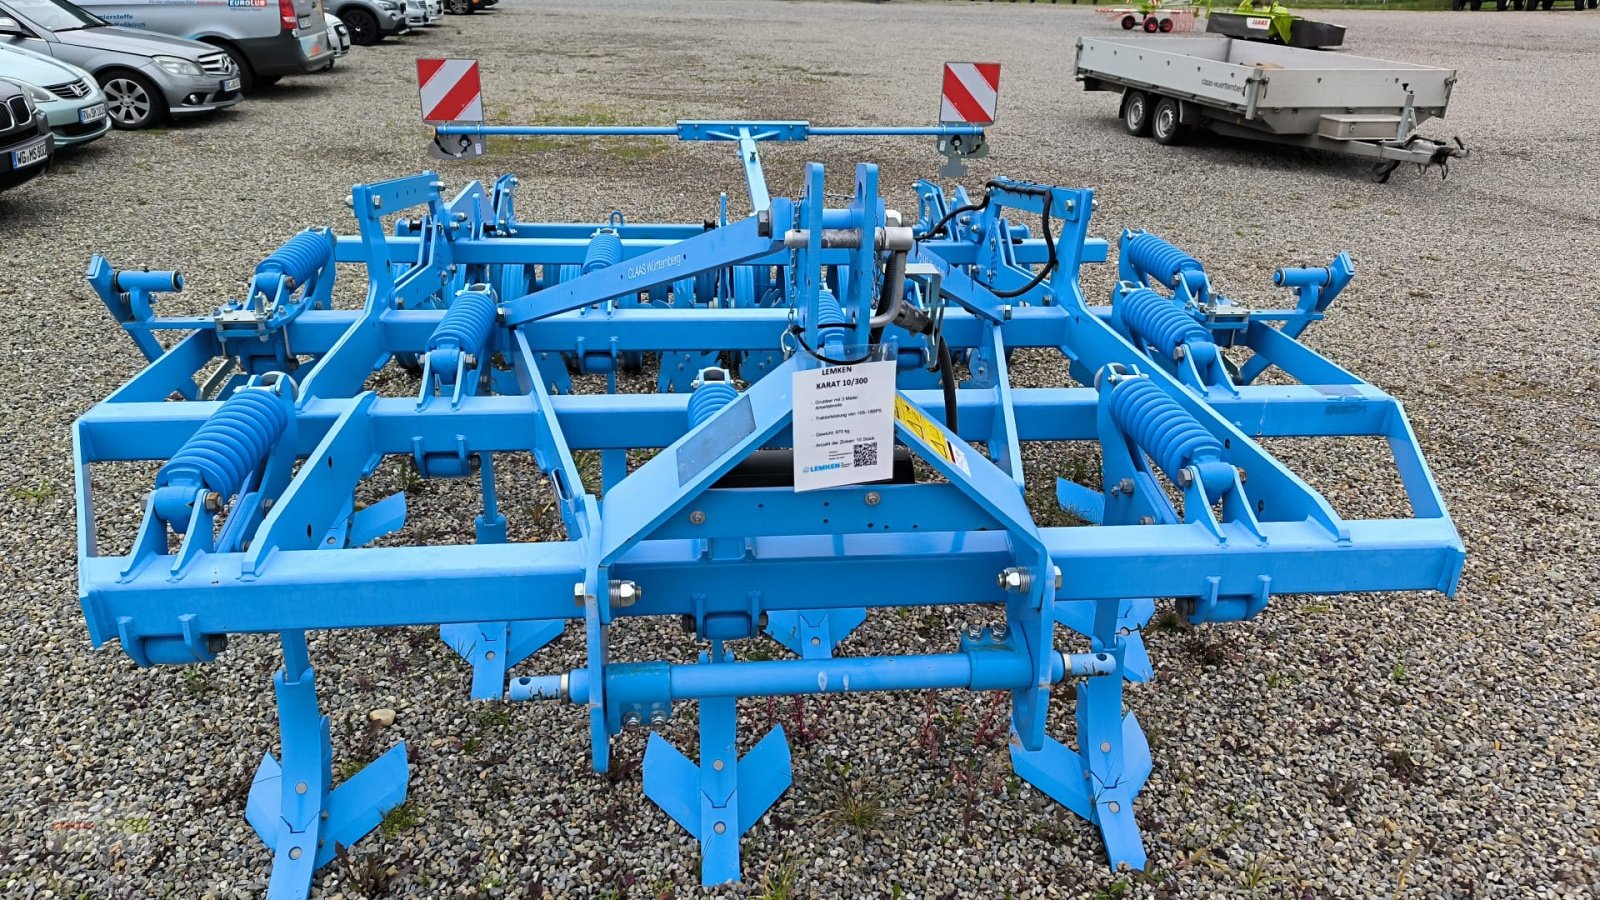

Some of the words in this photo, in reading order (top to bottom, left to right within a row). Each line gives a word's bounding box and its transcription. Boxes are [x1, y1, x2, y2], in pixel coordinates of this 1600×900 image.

[822, 366, 852, 376] LEMKEN
[816, 380, 841, 390] KARAT
[843, 377, 868, 387] 10/300
[811, 463, 840, 472] LEMKEN
